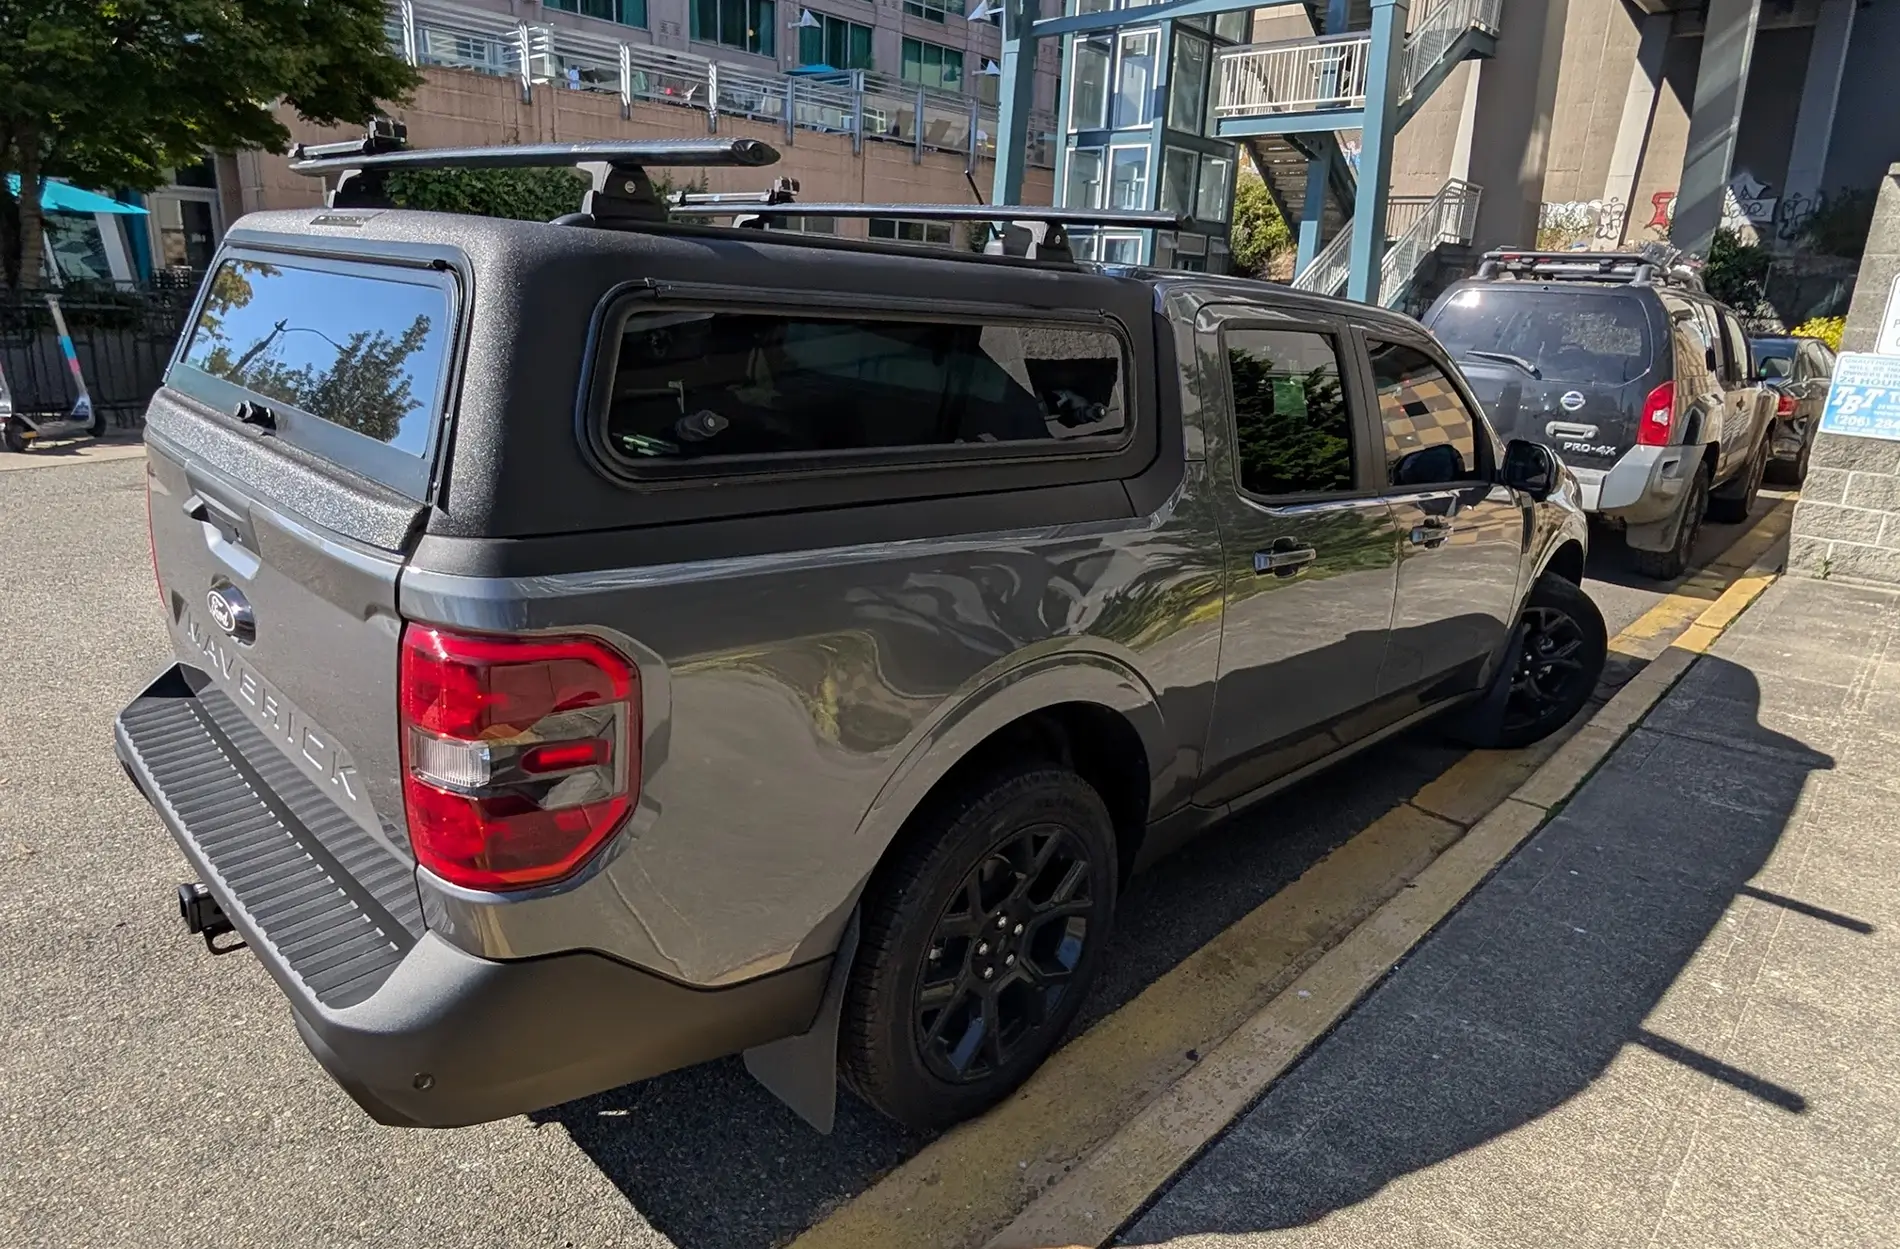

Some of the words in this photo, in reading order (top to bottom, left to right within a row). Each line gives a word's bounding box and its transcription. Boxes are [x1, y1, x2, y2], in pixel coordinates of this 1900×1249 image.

[1839, 375, 1856, 384] 24
[1831, 386, 1886, 415] TBT
[1562, 441, 1617, 456] PRO-4X
[210, 595, 229, 627] Ford
[186, 611, 357, 801] MAVERICK
